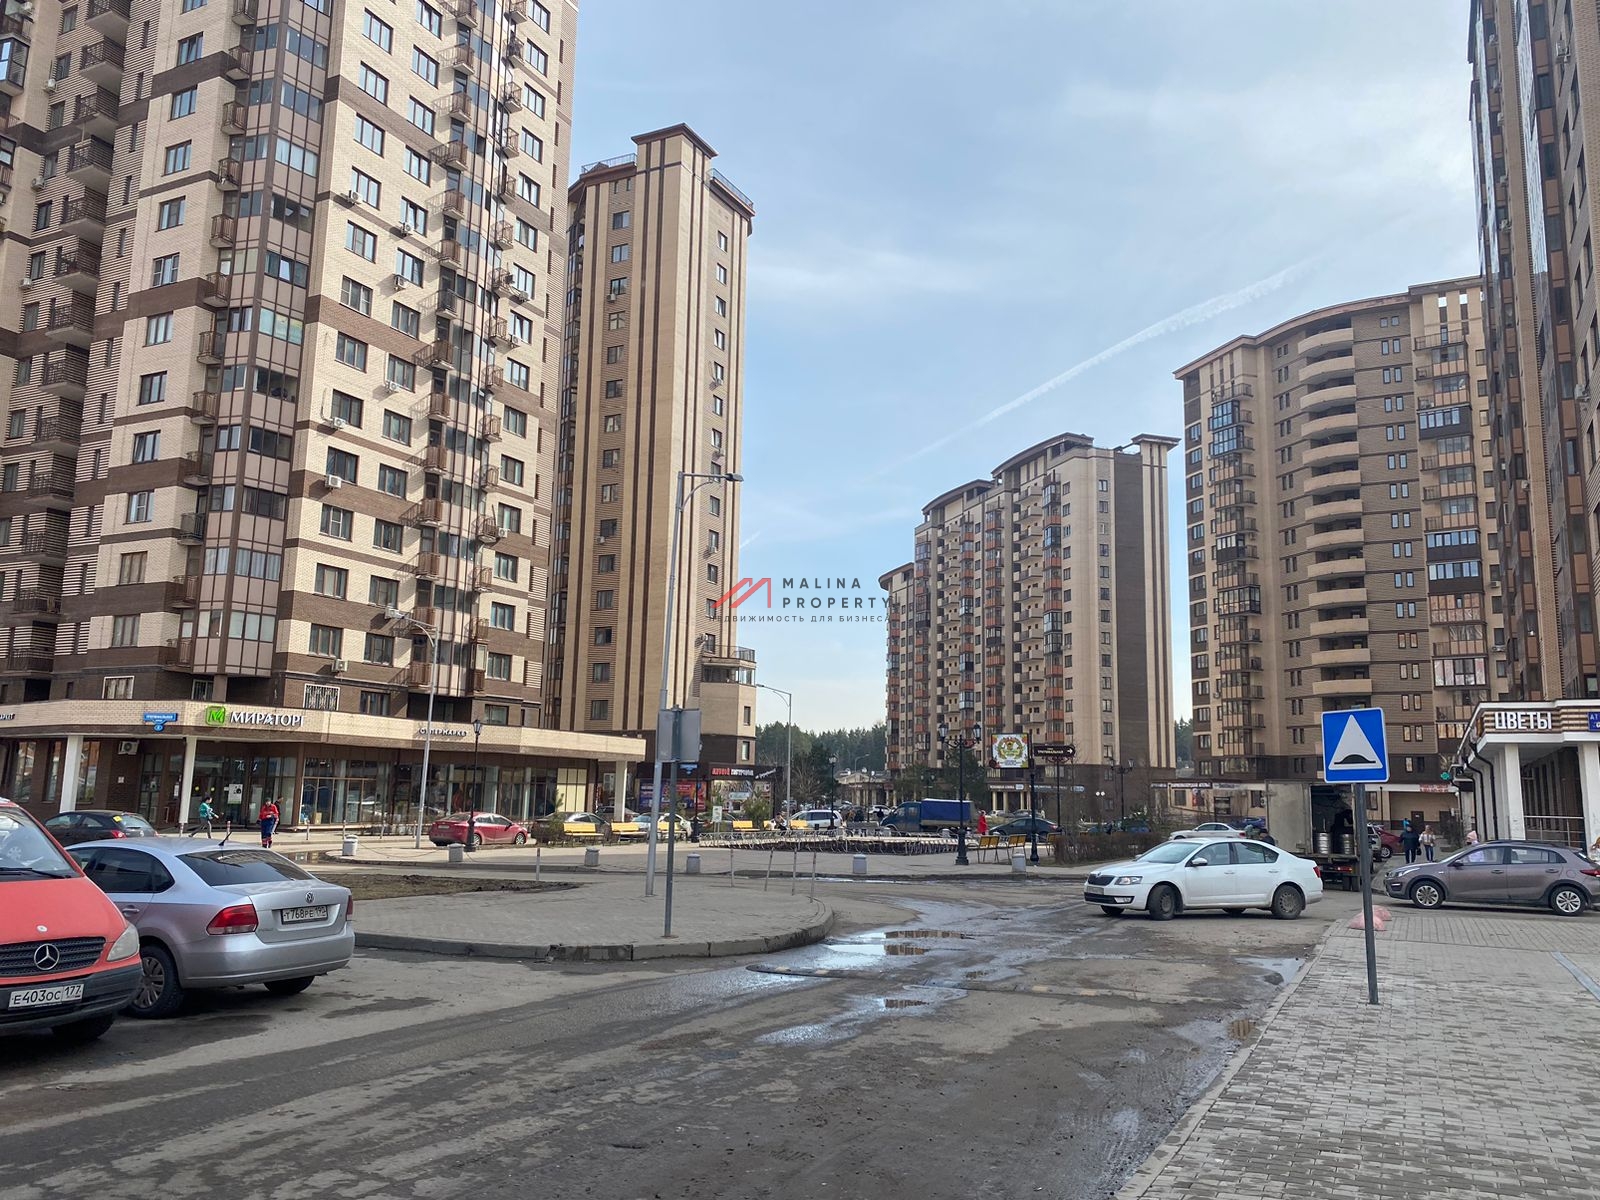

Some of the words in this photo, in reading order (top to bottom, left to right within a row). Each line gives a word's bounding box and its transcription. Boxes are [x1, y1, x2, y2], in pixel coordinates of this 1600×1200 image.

[230, 711, 305, 728] МИРАТОРГ
[1494, 711, 1552, 730] ЦВЕТЫ
[64, 985, 81, 996] 177
